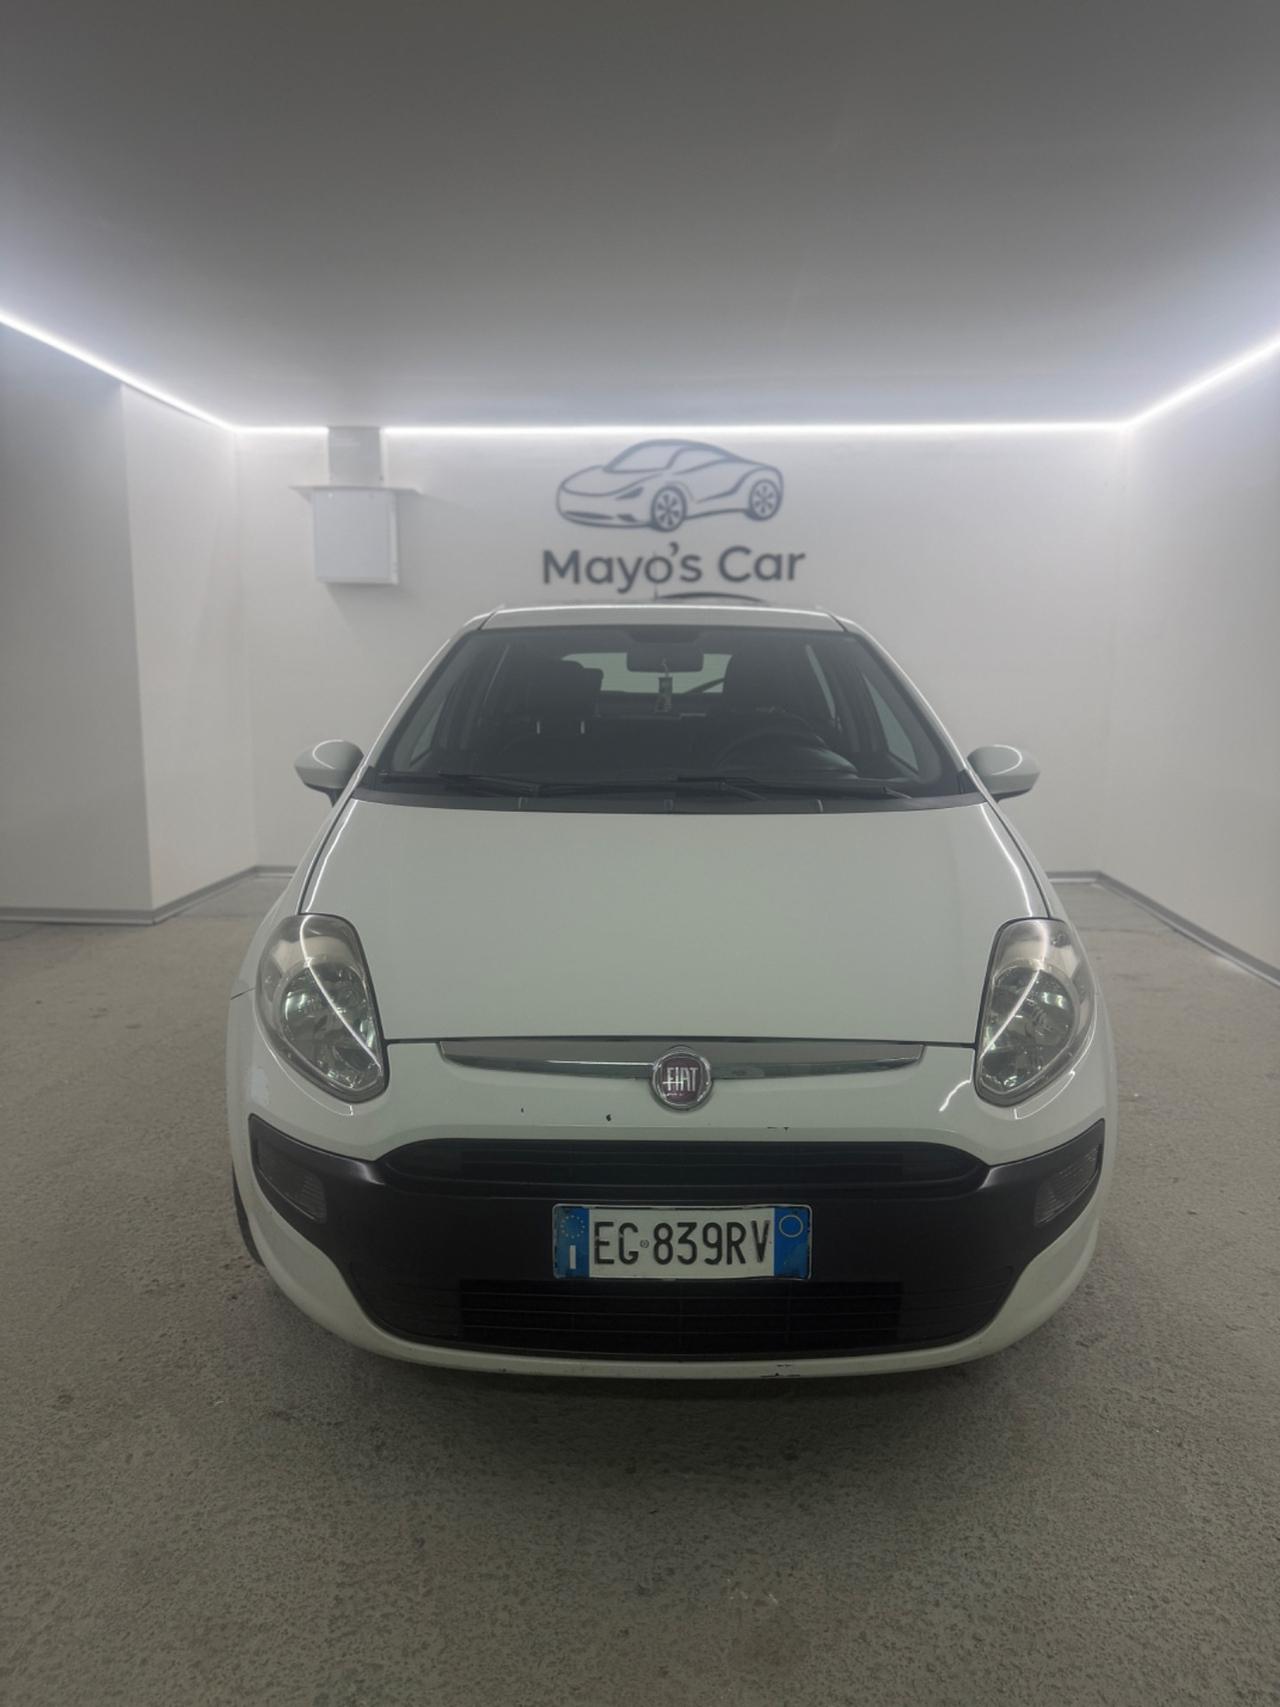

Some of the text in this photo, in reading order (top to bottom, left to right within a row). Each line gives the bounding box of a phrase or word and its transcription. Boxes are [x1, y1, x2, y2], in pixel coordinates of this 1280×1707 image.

[543, 541, 806, 594] Mayo's Car
[667, 1066, 699, 1092] FIAT
[593, 1219, 771, 1266] EG 839RV
